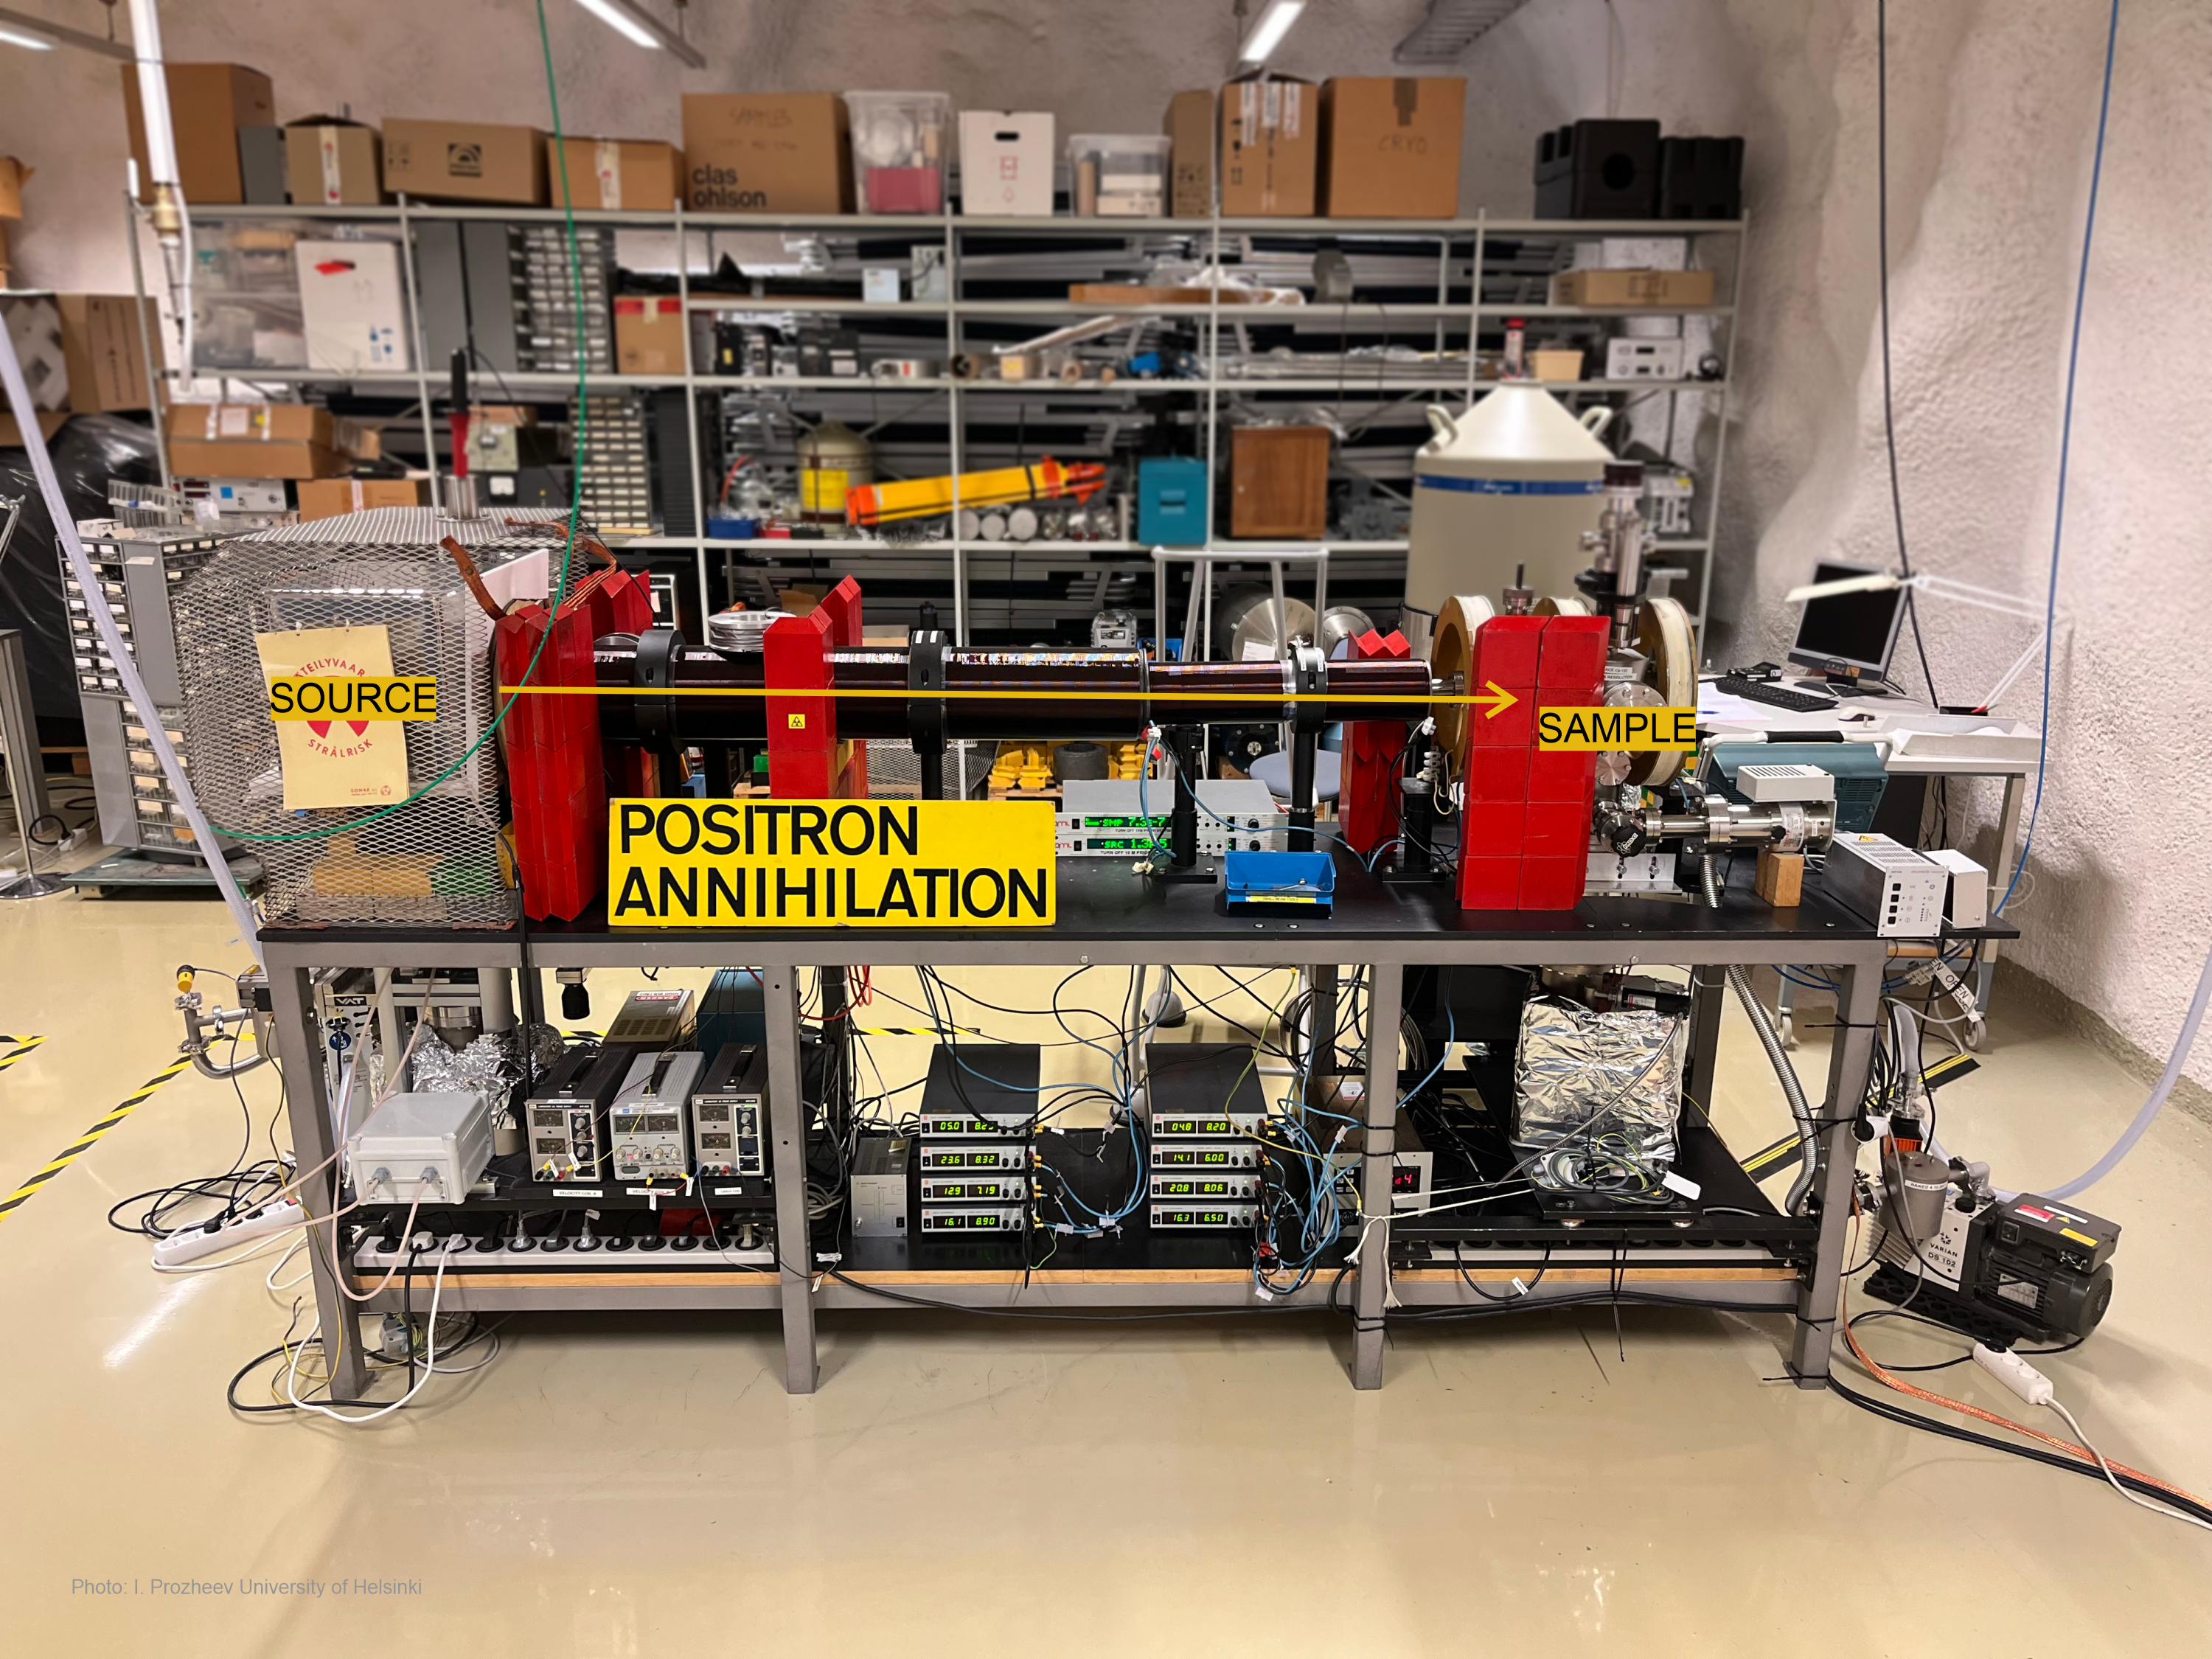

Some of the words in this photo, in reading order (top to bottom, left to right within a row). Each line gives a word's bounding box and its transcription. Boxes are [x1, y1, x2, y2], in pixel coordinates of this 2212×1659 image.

[1377, 133, 1428, 156] CRYO
[692, 163, 738, 185] clas
[692, 186, 767, 207] ohlson
[293, 658, 372, 678] ÄTEILYVAAR
[307, 738, 374, 758] STRÅLRISK
[1102, 818, 1124, 827] SMP
[620, 804, 918, 856] POSITRON
[1104, 841, 1124, 849] SRC
[614, 866, 1047, 919] ANNIHILATION
[940, 1121, 960, 1130] 05.0
[1172, 1122, 1192, 1131] 04.8
[1206, 1122, 1226, 1131] 8.20
[940, 1155, 960, 1164] 23.6
[975, 1155, 995, 1164] 8.32
[1173, 1154, 1190, 1162] 14.1
[1204, 1153, 1224, 1161] 6.00
[944, 1186, 961, 1195] 12.9
[1169, 1183, 1189, 1192] 20.8
[1203, 1183, 1223, 1192] 8.06
[944, 1218, 961, 1226] 16.1
[975, 1217, 995, 1225] 8.90
[1173, 1214, 1190, 1222] 16.3
[1204, 1214, 1224, 1222] 6.50
[1930, 1242, 1958, 1257] VARIAN
[1928, 1252, 1939, 1261] DS
[1942, 1258, 1956, 1267] 102
